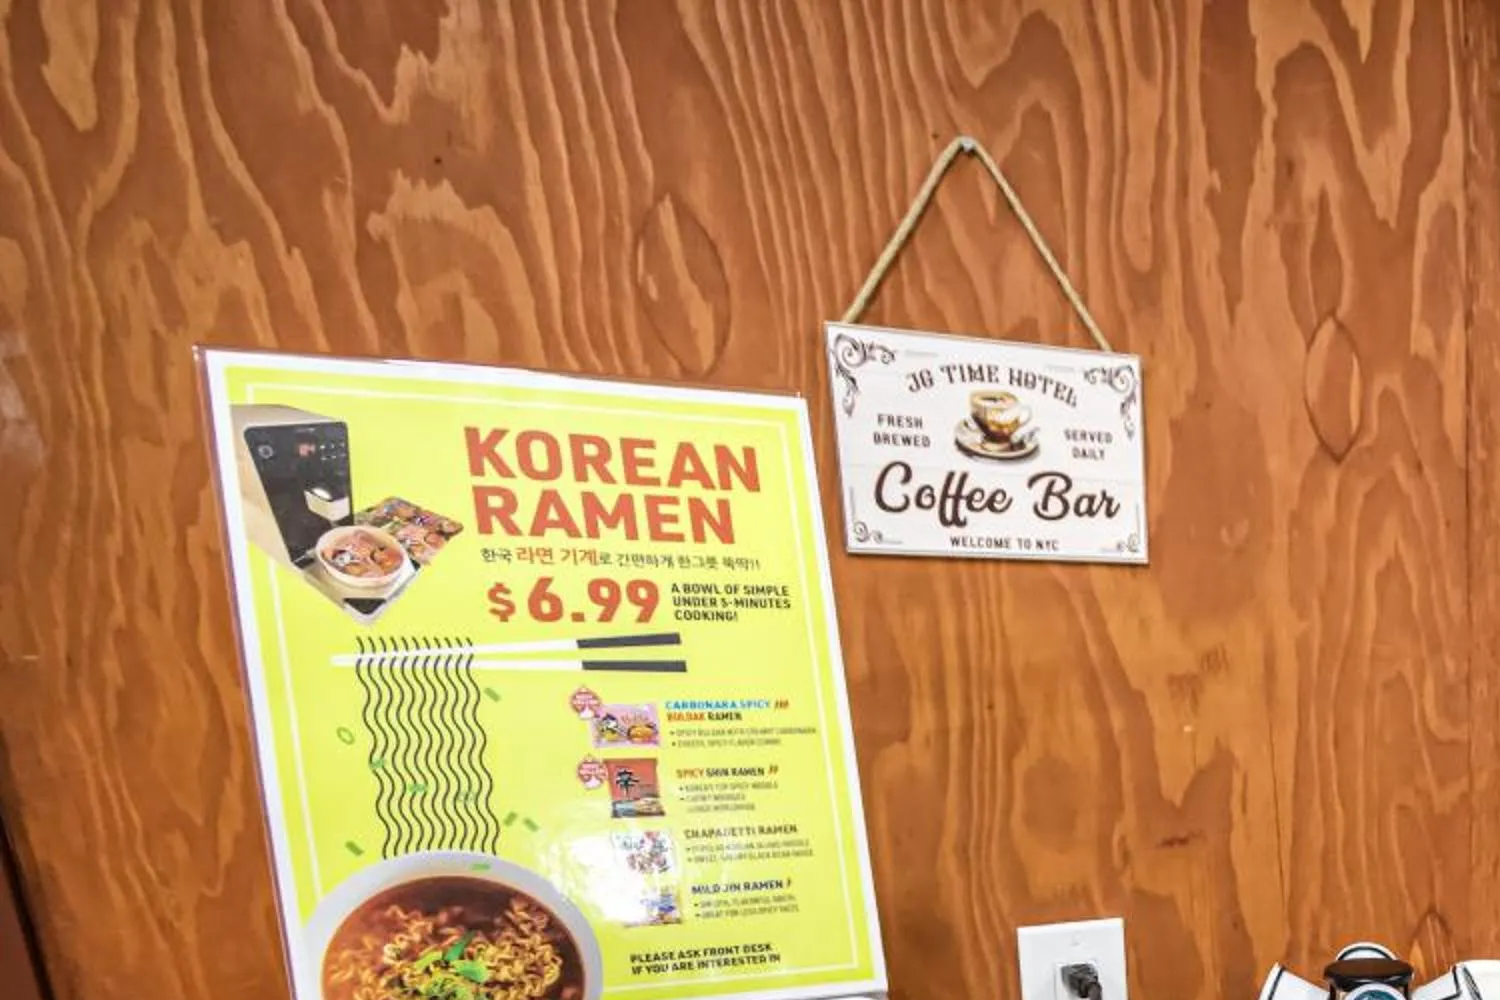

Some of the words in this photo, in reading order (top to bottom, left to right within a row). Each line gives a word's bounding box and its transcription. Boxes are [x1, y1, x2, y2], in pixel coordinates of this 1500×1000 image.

[905, 370, 935, 393] JG
[940, 364, 1000, 386] TIME
[1008, 366, 1078, 409] HOTEL
[877, 413, 924, 429] FRESH
[873, 431, 931, 449] BREWED
[1063, 428, 1113, 445] SERVED
[464, 426, 761, 493] KOREAN
[1072, 444, 1106, 460] DAILY
[874, 461, 1013, 528] Coffee
[1028, 471, 1121, 521] Bar
[472, 486, 735, 545] RAMEN
[950, 535, 1013, 550] WELCOME
[1017, 536, 1032, 550] TO
[1036, 537, 1060, 551] NYC
[480, 547, 512, 564] 한국
[516, 546, 555, 564] 라면
[560, 547, 613, 566] 기계로
[671, 583, 680, 593] A
[683, 583, 722, 595] BOWL
[724, 584, 740, 595] OF
[743, 585, 790, 597] SIMPLE
[487, 576, 660, 623] $6.99
[672, 596, 718, 608] UNDER
[721, 597, 791, 609] 5-MINUTES
[707, 711, 742, 721] RAMEN
[676, 768, 704, 778] SPICY
[731, 766, 764, 776] RAMEN
[758, 824, 797, 835] RAMEN
[743, 880, 783, 891] RAMEN
[630, 950, 675, 963] PLEASE
[677, 948, 701, 960] ASK
[703, 945, 740, 957] FRONT
[743, 943, 773, 953] DESK
[632, 965, 644, 975] IF
[645, 963, 669, 975] YOU
[671, 961, 695, 972] ARE
[768, 953, 781, 964] IN
